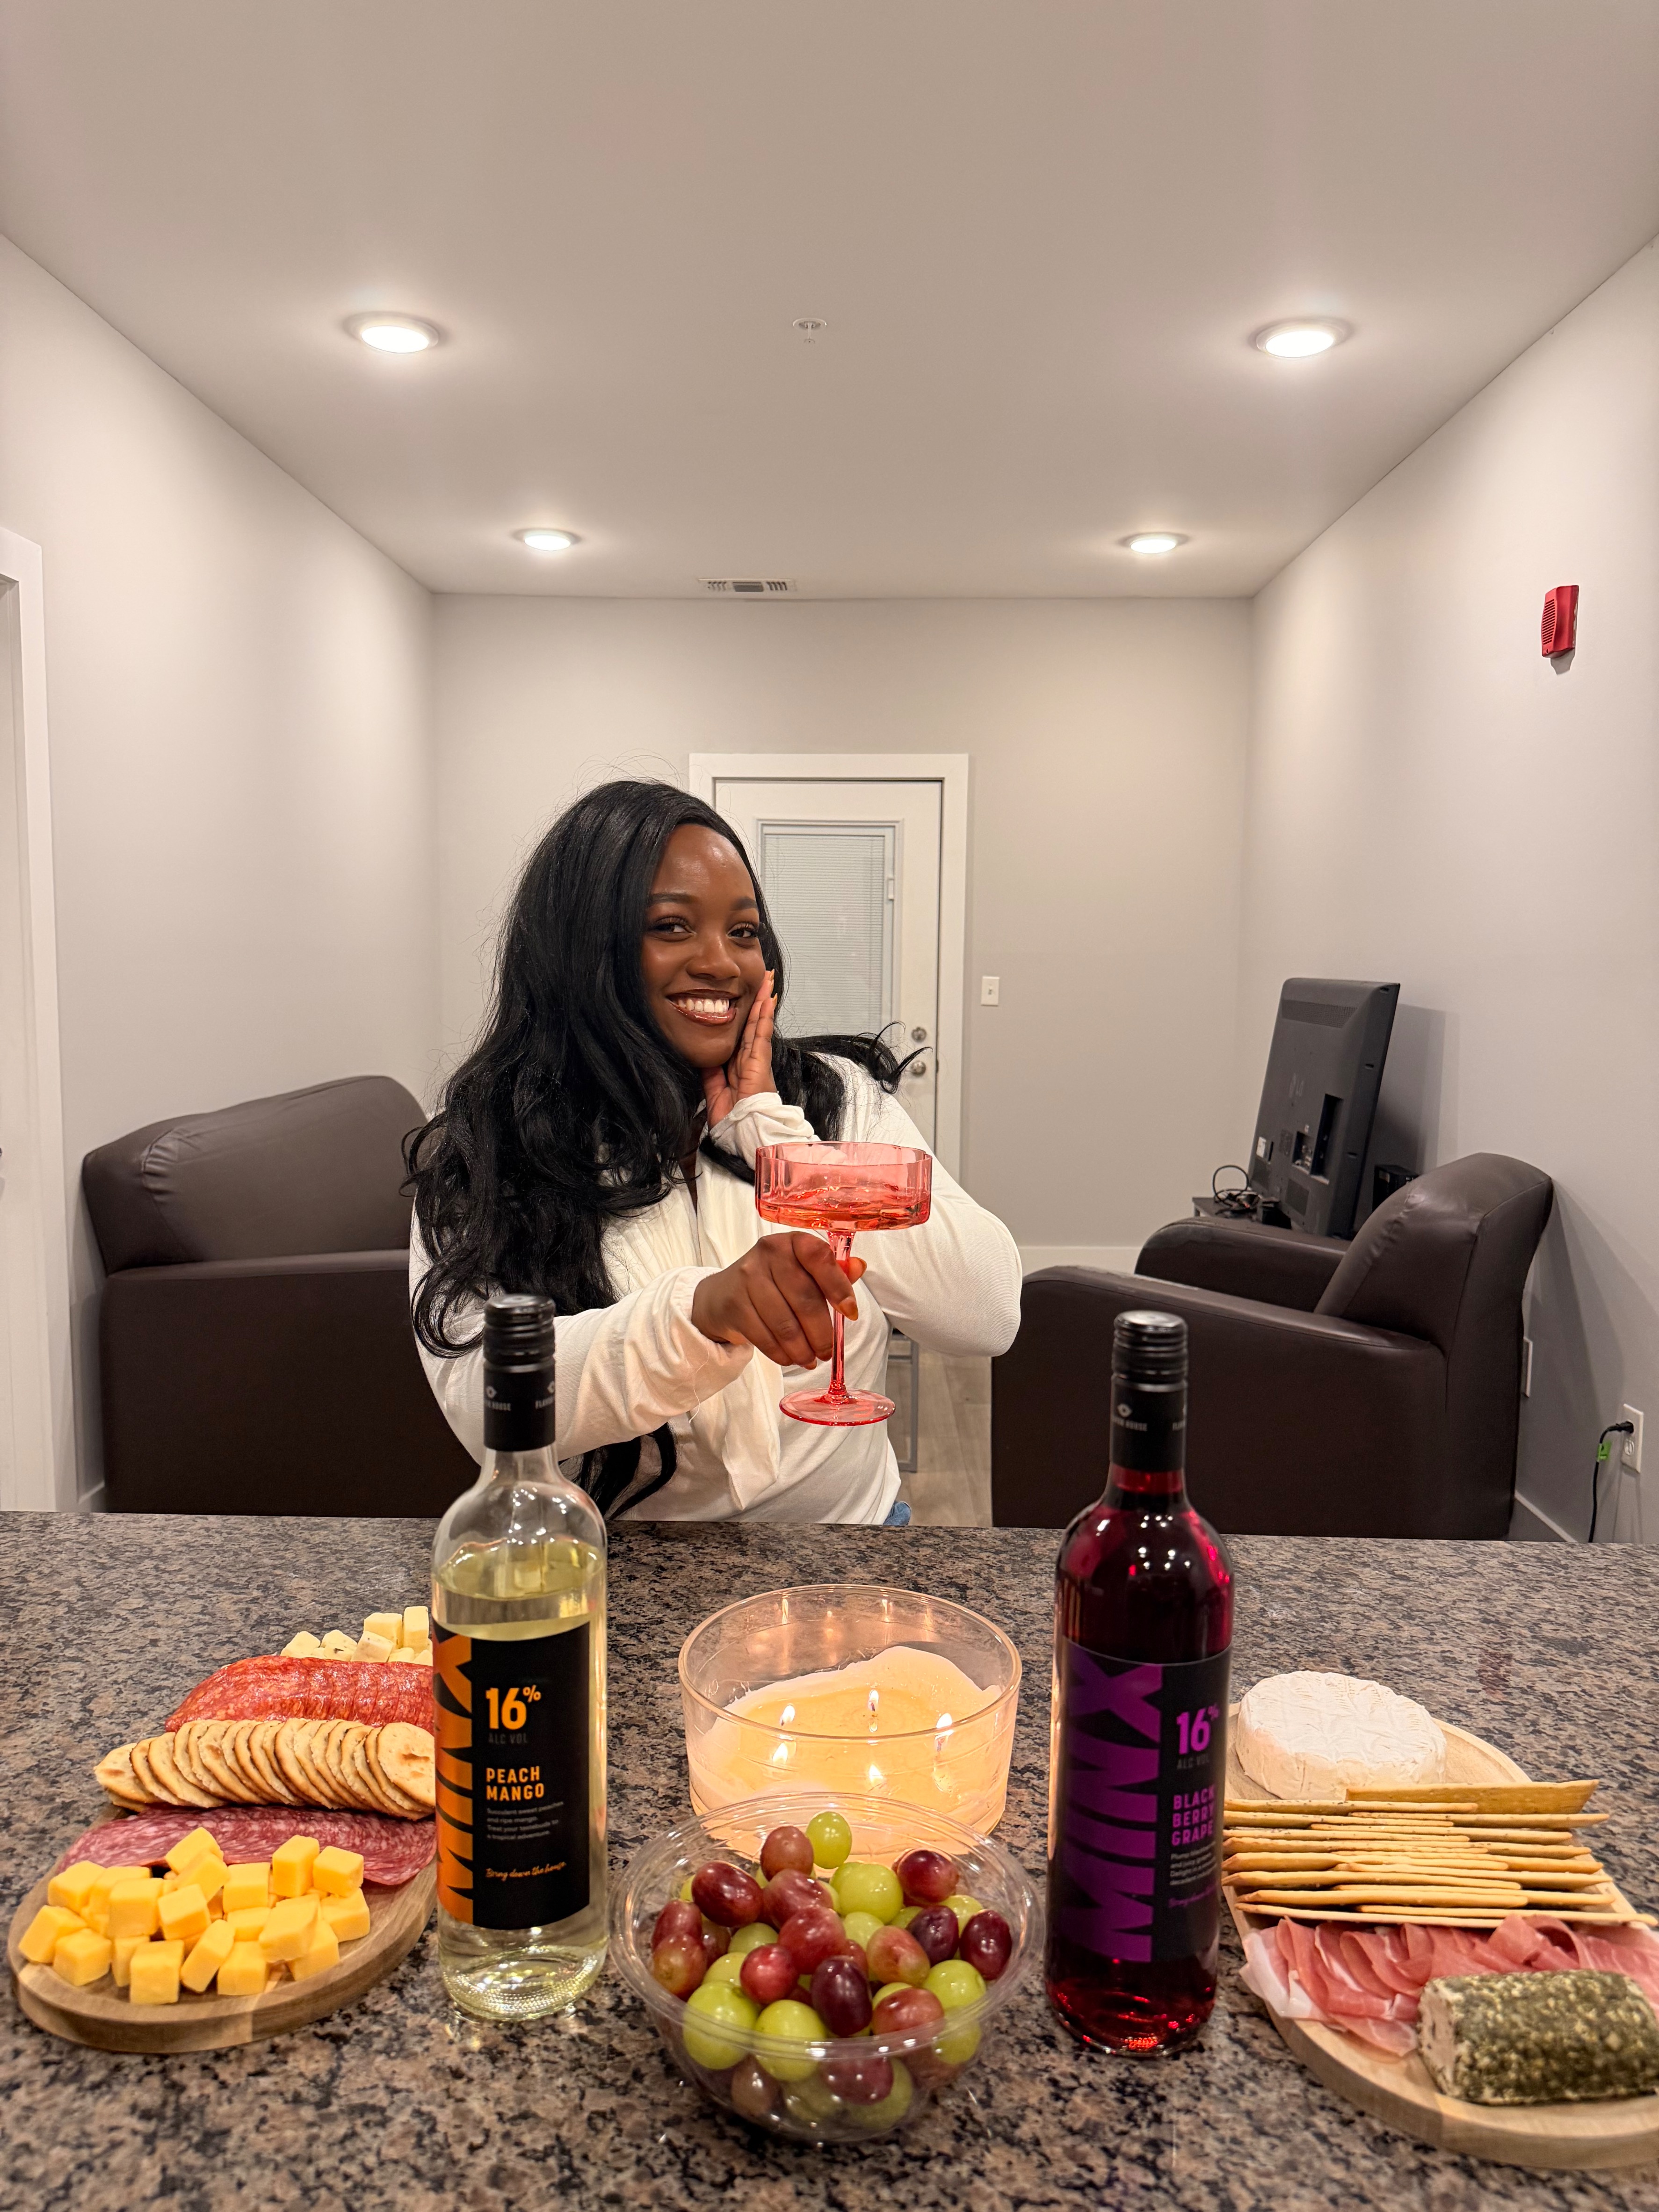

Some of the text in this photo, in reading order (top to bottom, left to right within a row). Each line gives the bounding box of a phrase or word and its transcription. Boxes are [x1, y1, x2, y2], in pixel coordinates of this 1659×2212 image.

[485, 1685, 541, 1730] 16%
[489, 1732, 528, 1744] ALC VOL
[1176, 1703, 1220, 1755] 16%
[486, 1766, 540, 1784] PEACH
[486, 1783, 544, 1801] MANGO
[1058, 1639, 1163, 1963] MINX
[1173, 1784, 1215, 1810] BLACK
[1172, 1801, 1215, 1828] BERRY
[1171, 1819, 1214, 1846] GRAPE
